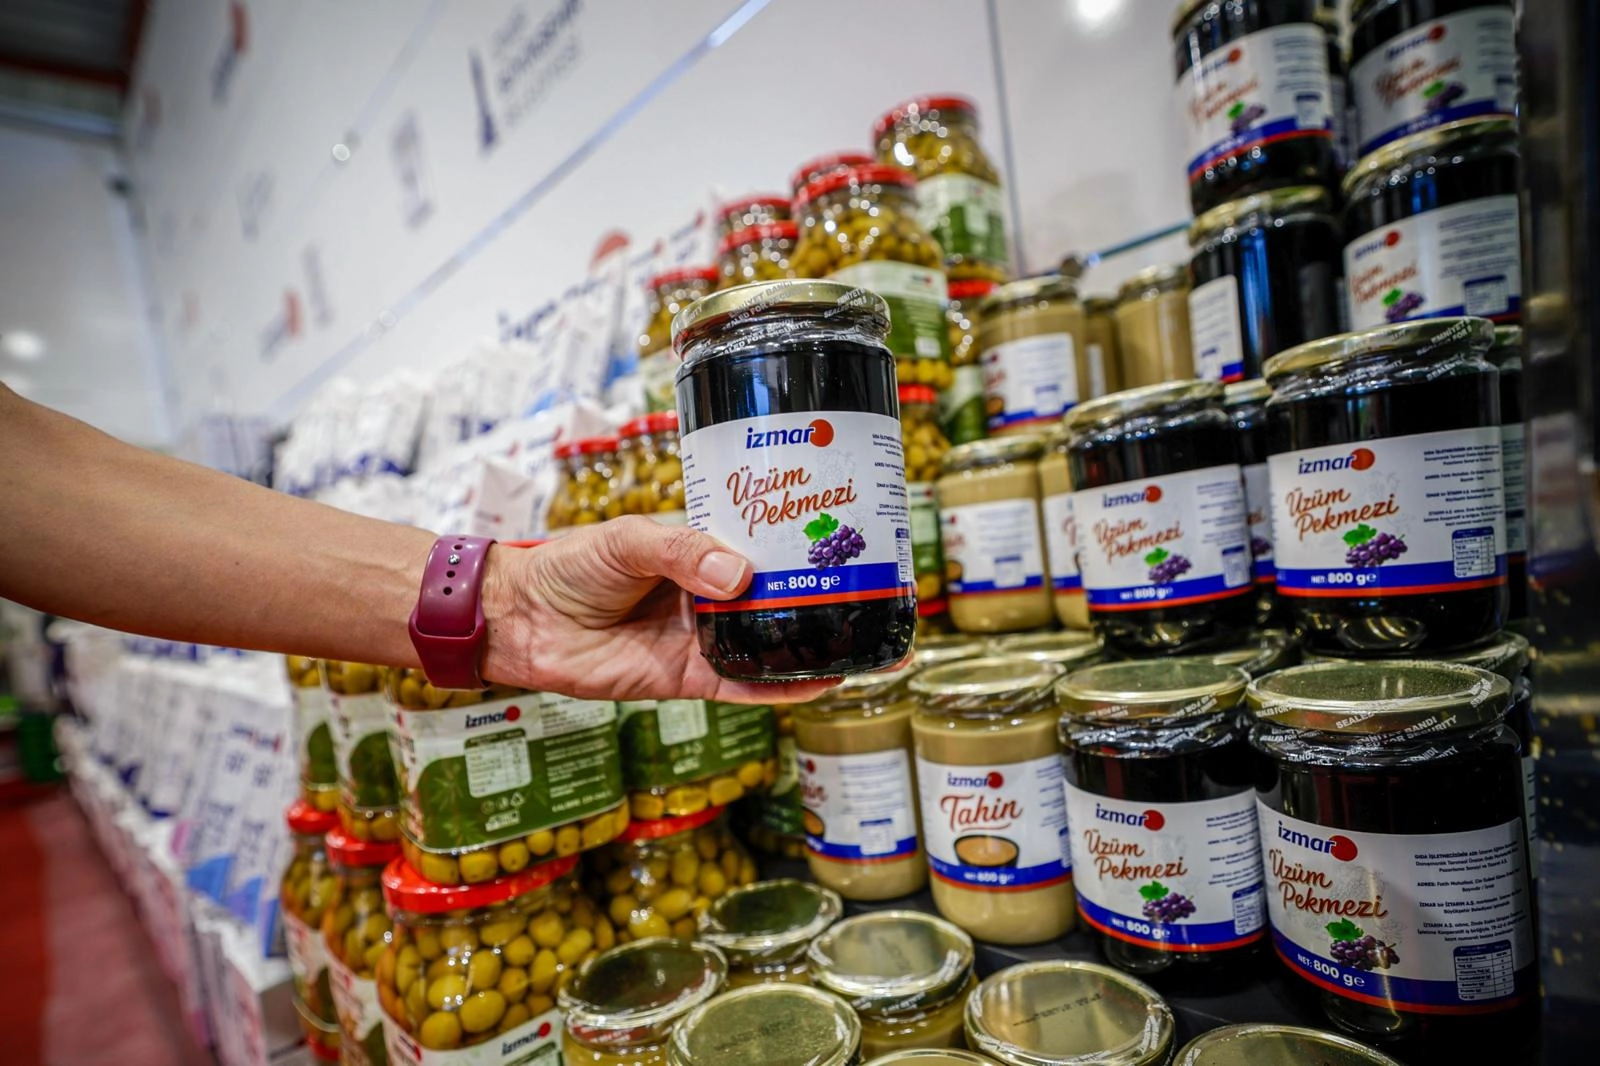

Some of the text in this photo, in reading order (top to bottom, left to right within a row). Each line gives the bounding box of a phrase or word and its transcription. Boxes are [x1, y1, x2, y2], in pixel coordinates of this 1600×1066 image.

[745, 427, 815, 449] izmar
[1298, 454, 1356, 475] izmar
[727, 465, 811, 506] Üzüm
[742, 478, 857, 537] Pekmezi
[1103, 492, 1147, 508] izmar
[1285, 487, 1351, 518] Üzüm
[1093, 517, 1147, 545] Üzüm
[1295, 494, 1400, 542] Pekmezi
[1106, 521, 1184, 564] Pekmezi
[767, 581, 787, 591] NET:
[788, 575, 818, 589] 800
[1328, 573, 1353, 585] 800
[1336, 710, 1375, 729] SEALED
[1404, 716, 1437, 734] BANDI
[948, 773, 990, 788] izmar
[940, 795, 1023, 831] Tahin
[1095, 803, 1149, 827] izmar
[1084, 829, 1145, 857] Üzüm
[1278, 820, 1336, 854] izmar
[1094, 856, 1188, 882] Pekmezi
[1269, 849, 1333, 888] Üzüm
[1278, 881, 1388, 919] Pekmezi
[1126, 921, 1150, 935] 800
[1297, 953, 1312, 968] NET:
[1313, 960, 1339, 980] 800
